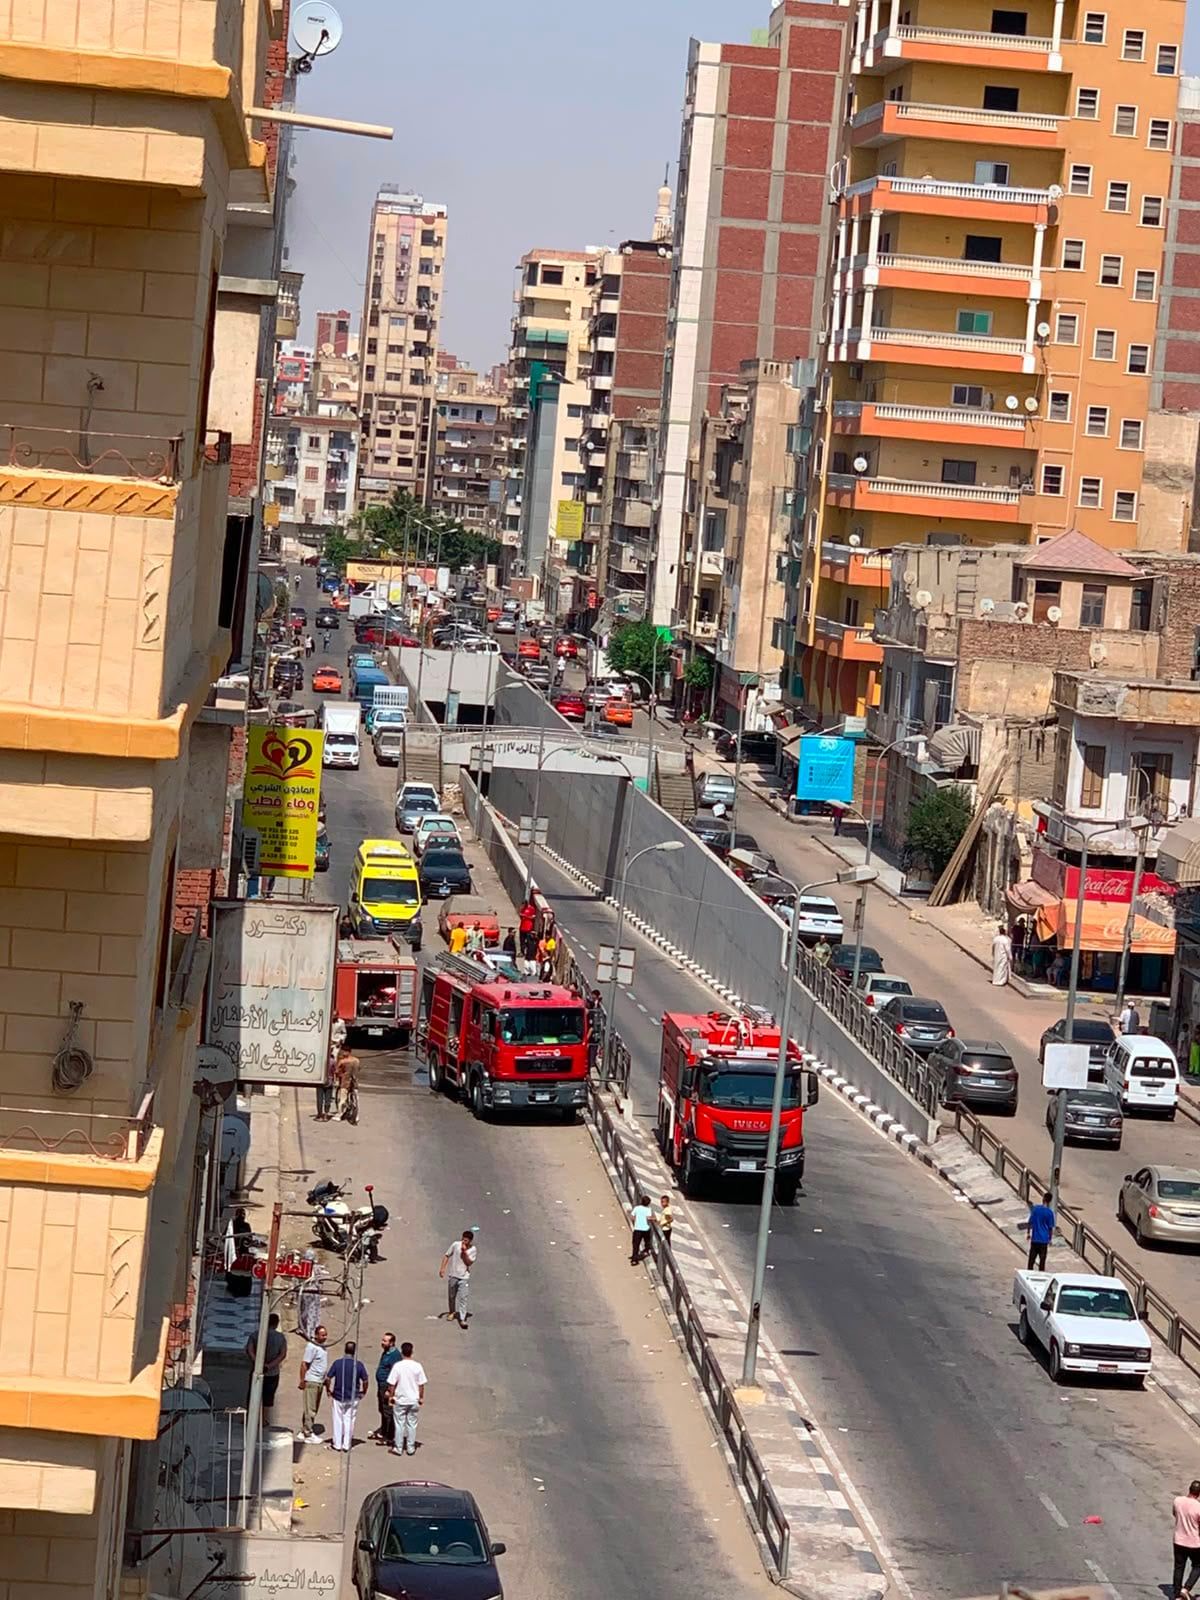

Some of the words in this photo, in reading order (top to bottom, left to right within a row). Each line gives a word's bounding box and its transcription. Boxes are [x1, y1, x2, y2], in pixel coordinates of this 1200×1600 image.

[245, 914, 308, 938] دكتور
[213, 1040, 260, 1070] الولا
[307, 1570, 336, 1597] عبد
